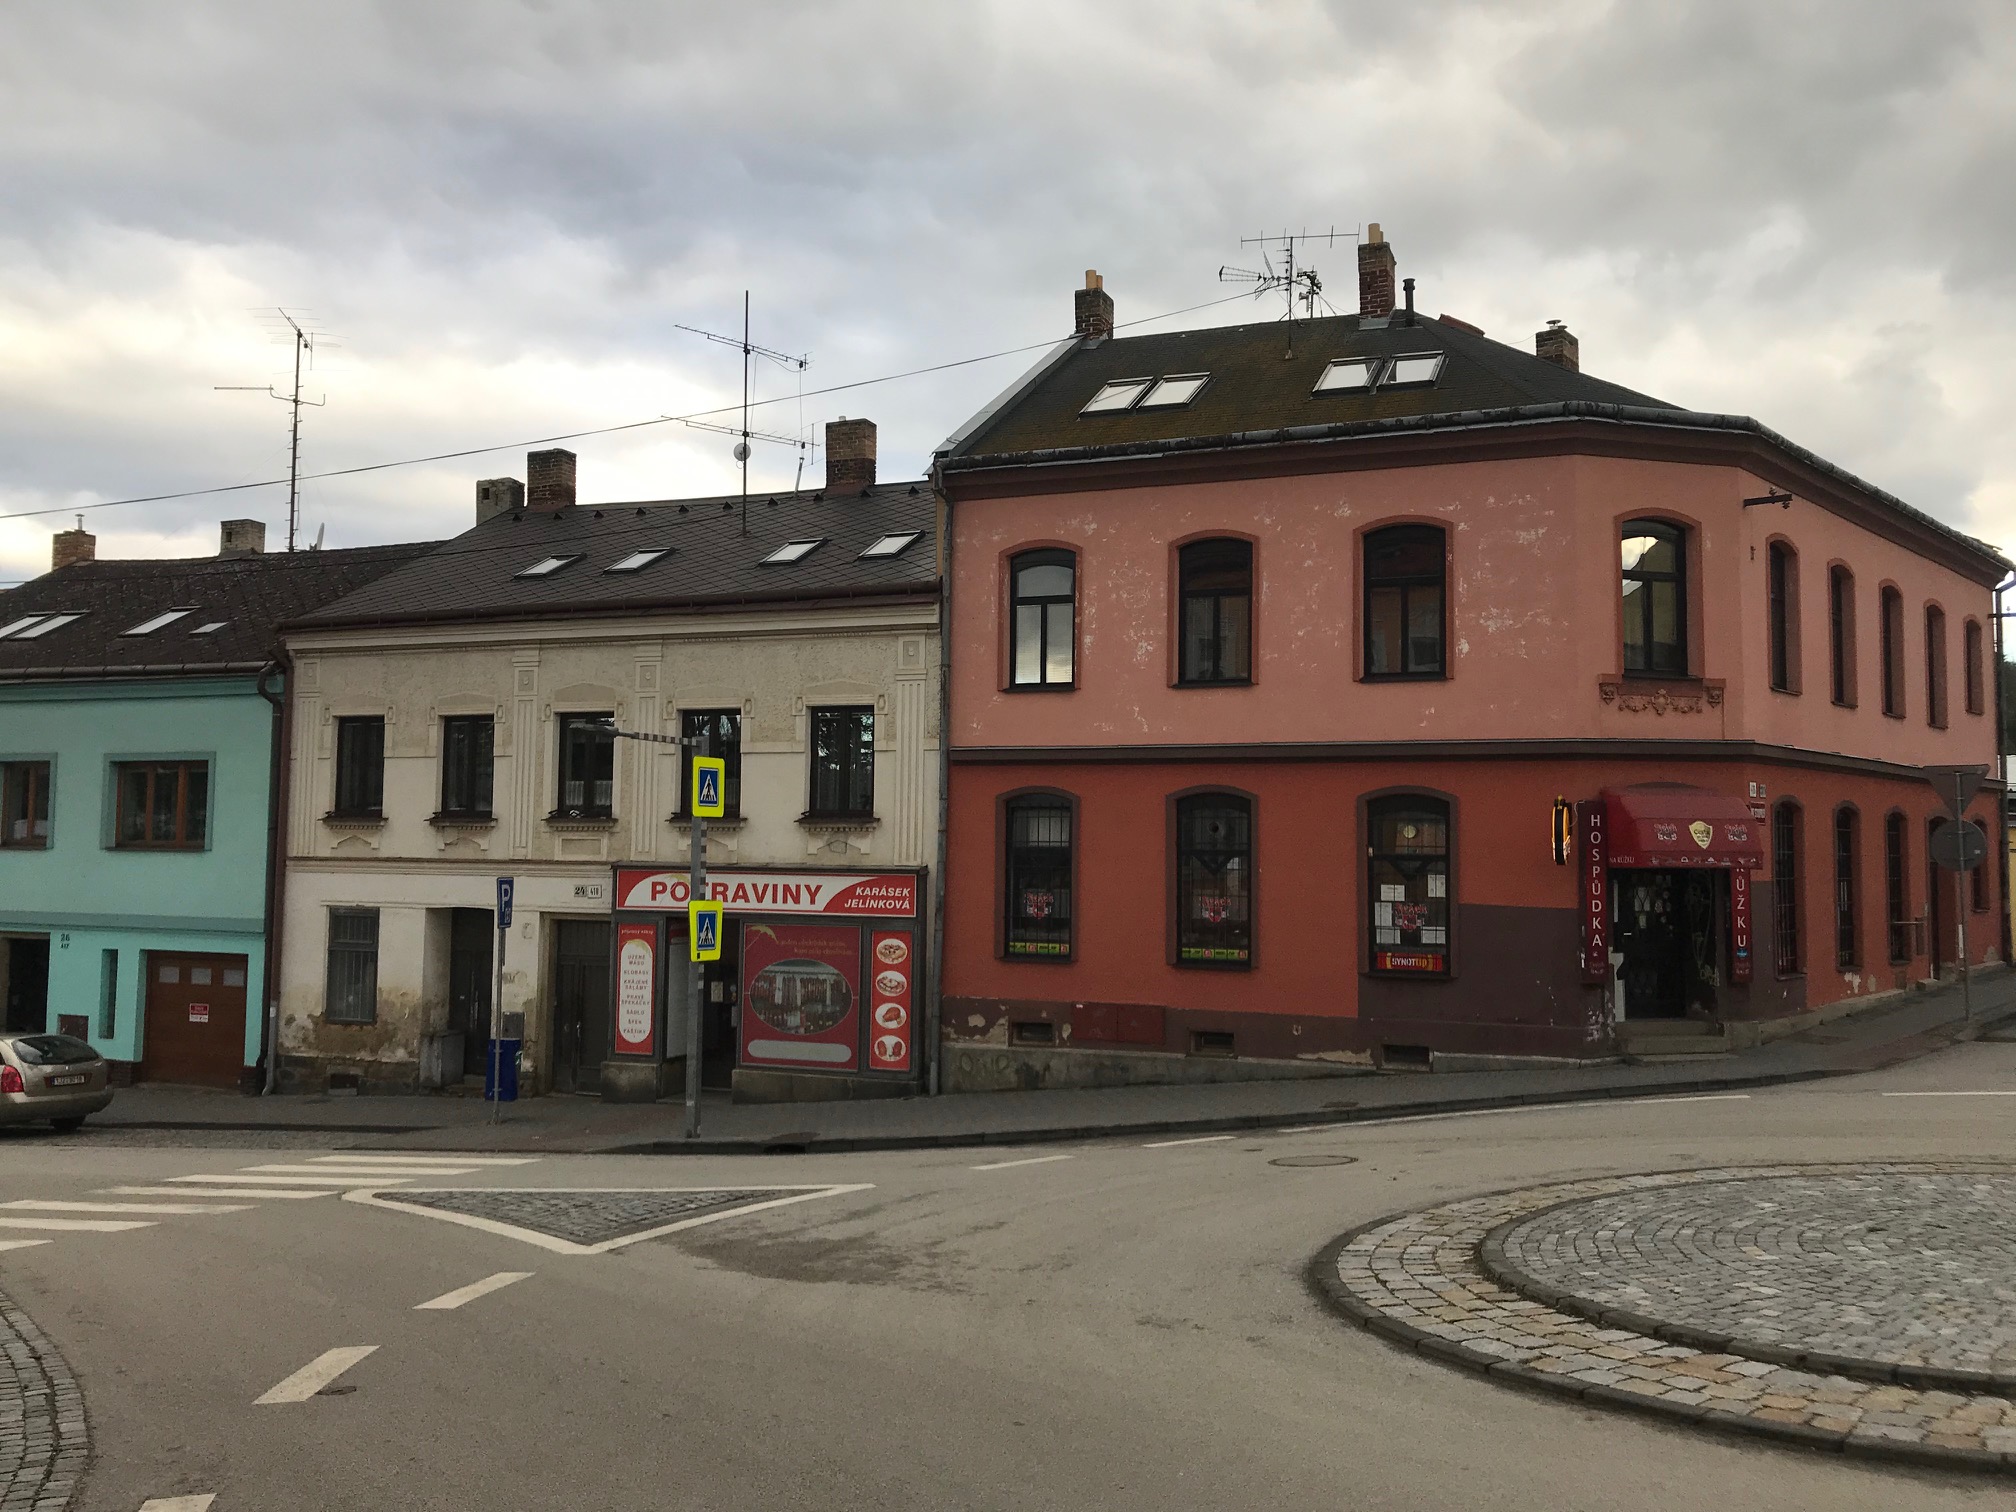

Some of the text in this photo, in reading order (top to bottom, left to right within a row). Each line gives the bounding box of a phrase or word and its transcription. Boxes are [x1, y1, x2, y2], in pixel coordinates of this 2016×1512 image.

[1590, 814, 1603, 947] HOSPŮDKA
[502, 884, 511, 912] P
[575, 886, 586, 896] 24
[650, 881, 823, 905] PORAVINY
[855, 885, 910, 897] KARÁSEK
[844, 897, 910, 910] JELÍNKOVÁ
